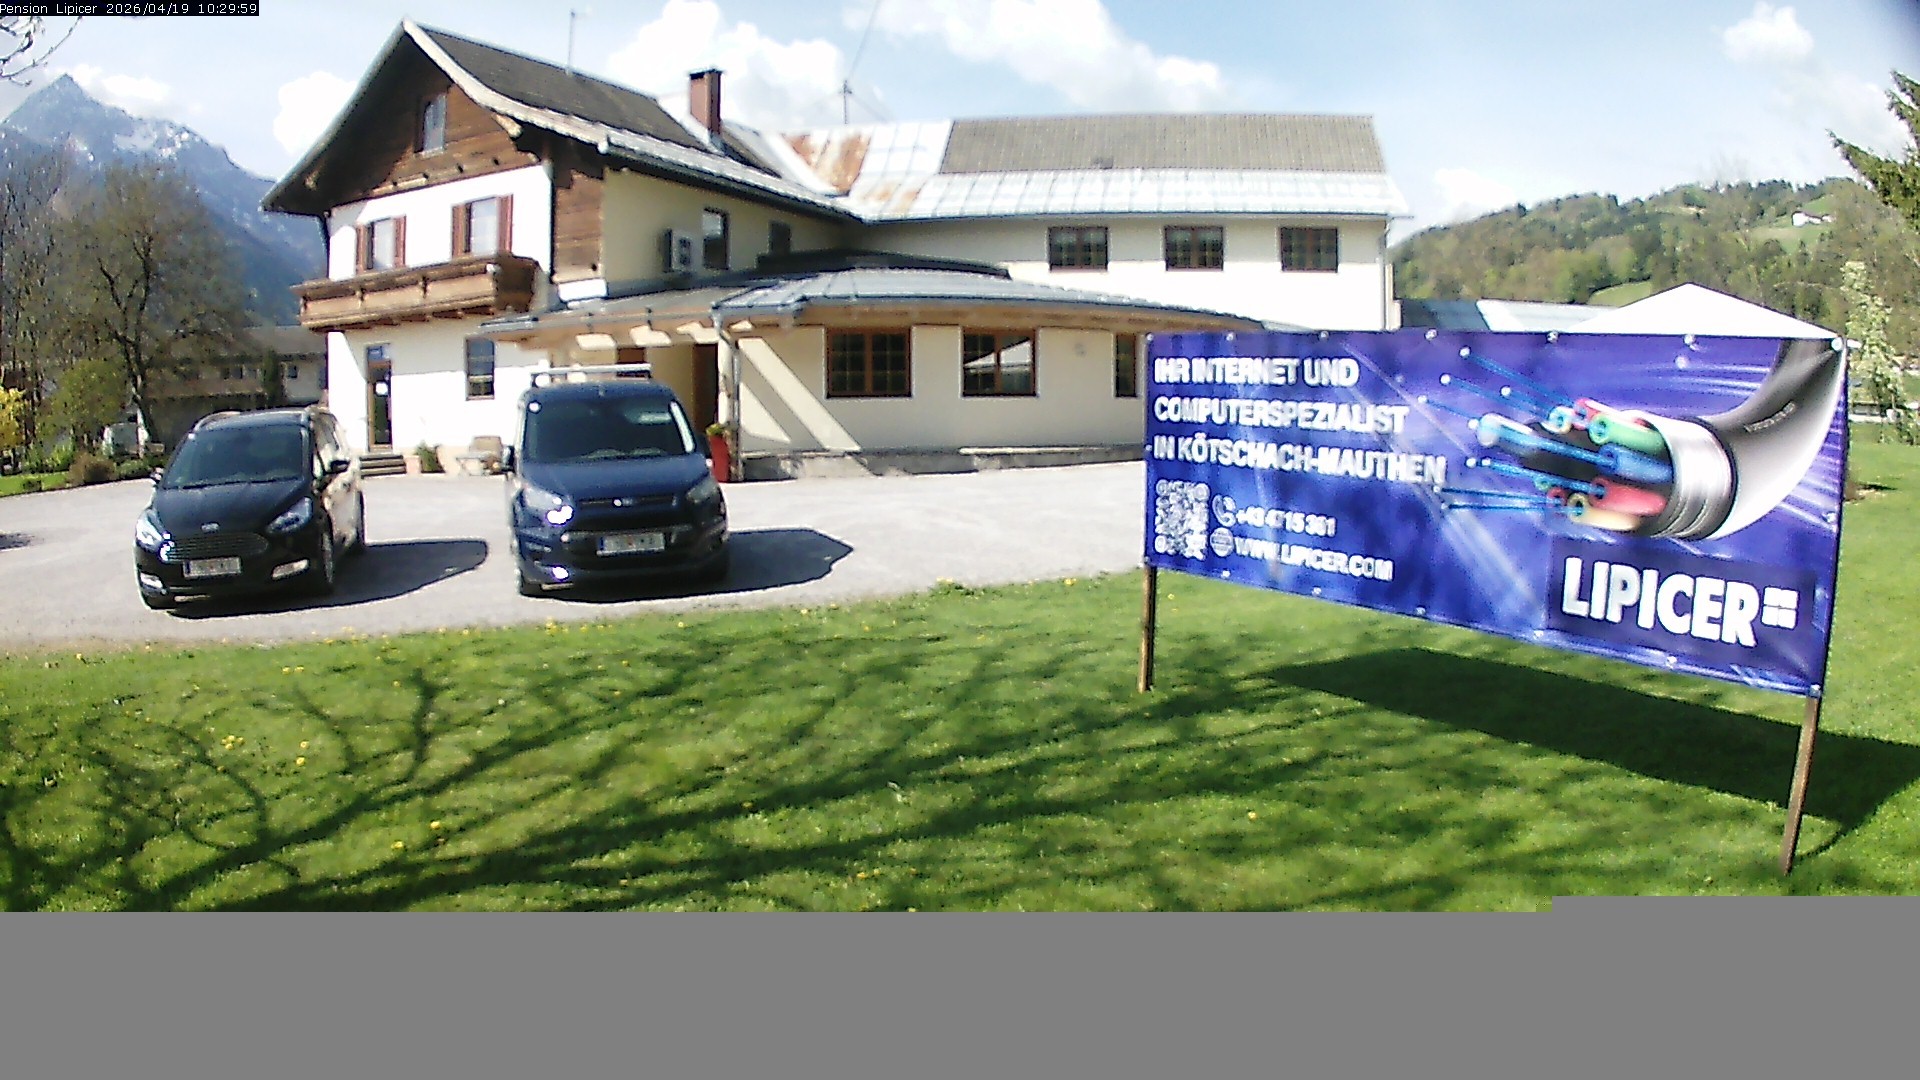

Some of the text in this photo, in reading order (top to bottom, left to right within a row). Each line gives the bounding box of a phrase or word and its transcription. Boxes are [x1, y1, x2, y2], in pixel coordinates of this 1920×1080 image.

[1154, 357, 1360, 387] IHR INTERNET UND
[1154, 396, 1410, 434] COMPUTERSPEZIALIST
[1153, 432, 1447, 484] IN KÖTSCHACH-MAUTHEN
[1234, 536, 1394, 582] WWW.LIPICER.COM
[1562, 556, 1760, 648] LIPICER
